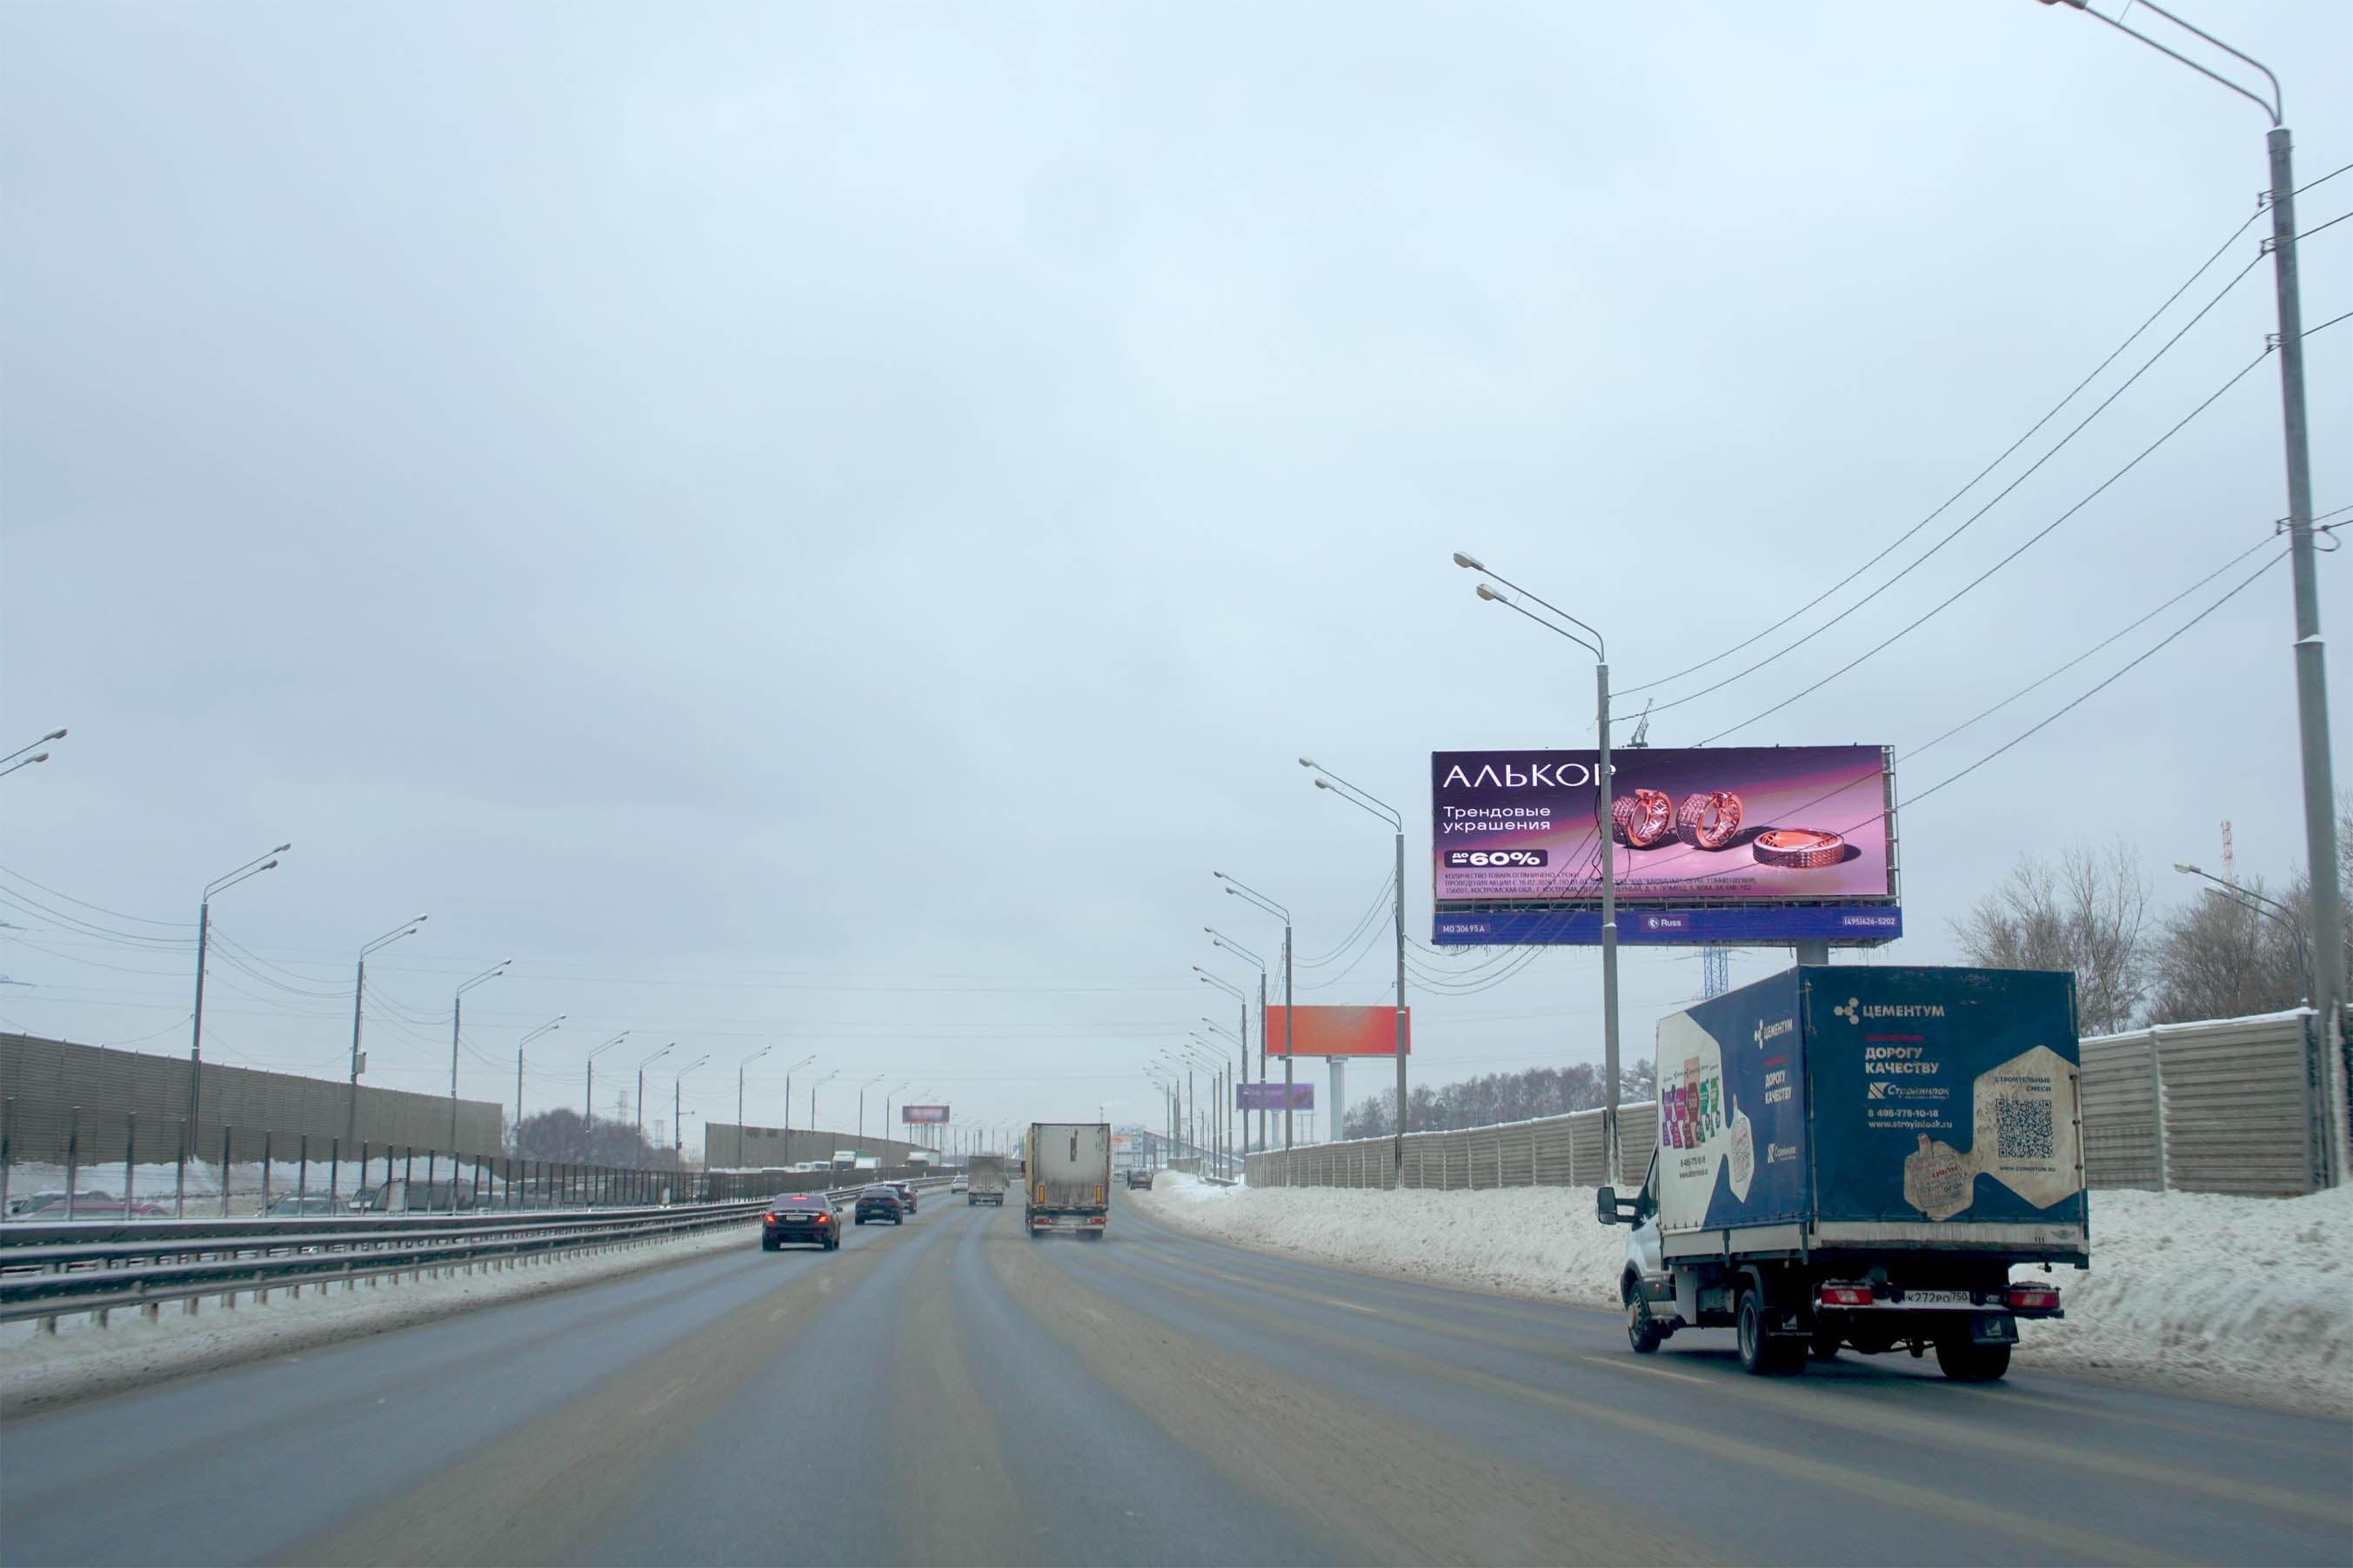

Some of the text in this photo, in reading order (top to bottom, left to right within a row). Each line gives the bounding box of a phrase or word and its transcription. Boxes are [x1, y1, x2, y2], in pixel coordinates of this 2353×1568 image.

[1443, 763, 1616, 788] АЛЬКОР
[1443, 806, 1551, 819] Трендовые
[1443, 821, 1551, 833] украшения
[1661, 918, 1681, 927] Russ
[1862, 1004, 1945, 1018] ЦЕМЕНТУМ
[1763, 1018, 1793, 1041] ЦЕМЕНТУМ
[1864, 1047, 1922, 1060] ДОРОГУ
[1865, 1062, 1940, 1074] КАЧЕСТВУ
[1765, 1070, 1786, 1089] ДОРОГУ
[1765, 1086, 1792, 1105] КАЧЕСТВУ
